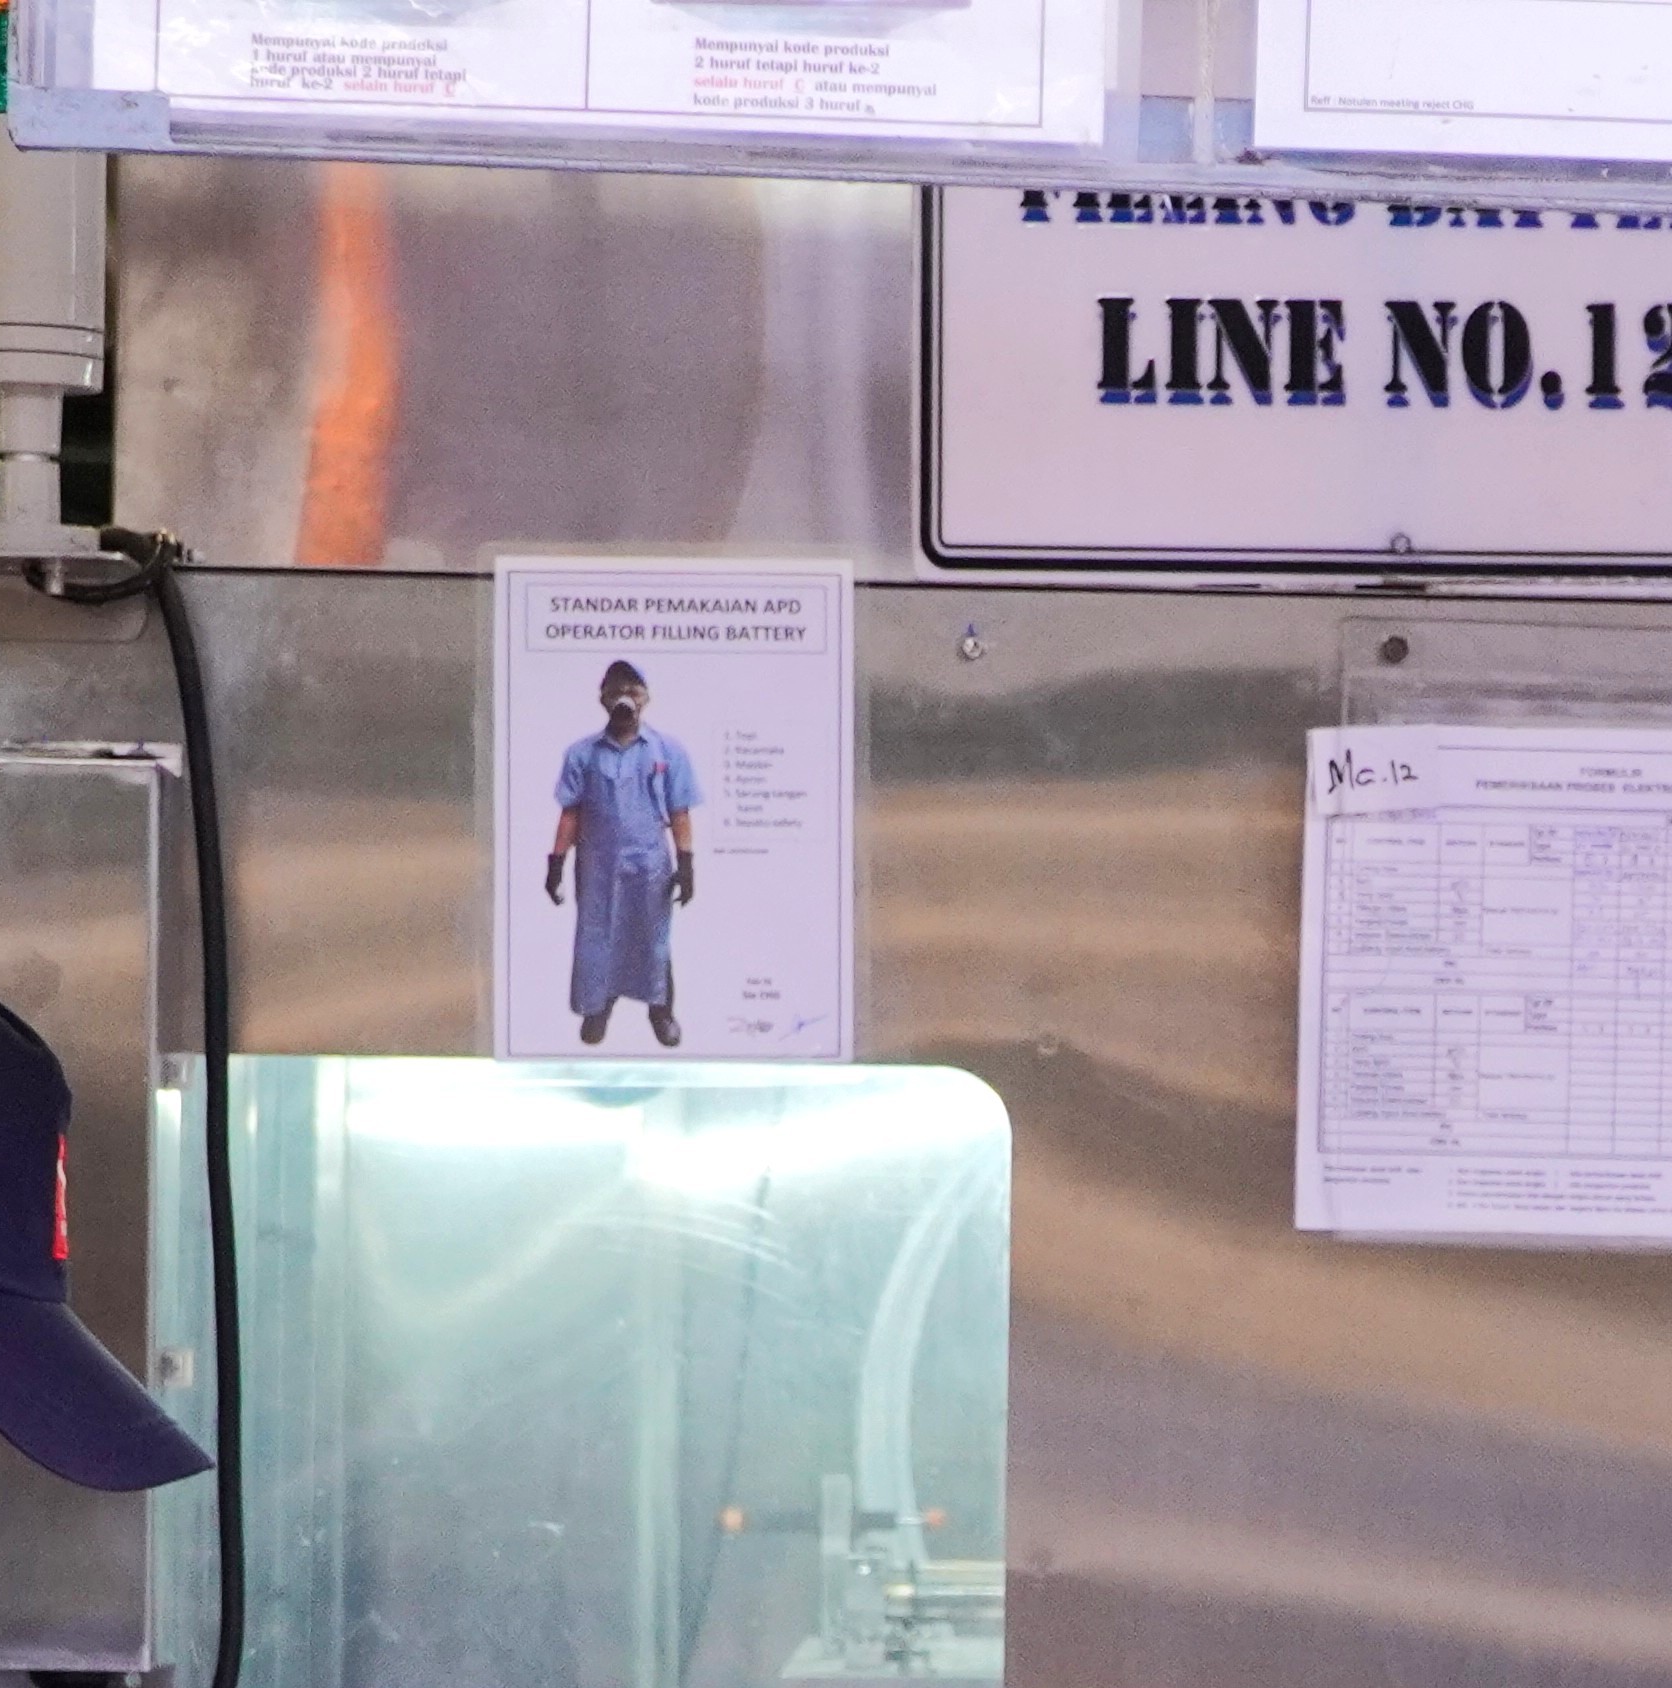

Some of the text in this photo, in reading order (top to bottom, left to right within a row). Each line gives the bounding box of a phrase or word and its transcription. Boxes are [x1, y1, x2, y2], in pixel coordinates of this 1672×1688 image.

[251, 33, 336, 49] Mempunyai
[695, 37, 890, 58] Mempunyai kode produksi
[266, 50, 307, 62] huruf
[312, 53, 346, 63] atau
[351, 53, 437, 67] mempunyai
[694, 57, 880, 75] 2 huruf tetapi huruf ke-2
[291, 64, 357, 78] produksi
[362, 66, 372, 77] 2
[378, 67, 420, 80] huruf
[301, 77, 333, 89] ke-2
[814, 81, 847, 93] atau
[852, 81, 938, 97] mempunyai
[693, 93, 729, 106] kode
[733, 94, 799, 110] produksi
[819, 98, 861, 113] huruf
[1097, 298, 1347, 406] LINE
[550, 597, 802, 614] STANDAR PEMAKAIAN APD
[545, 624, 807, 641] OPERATOR FILLING BATTERY
